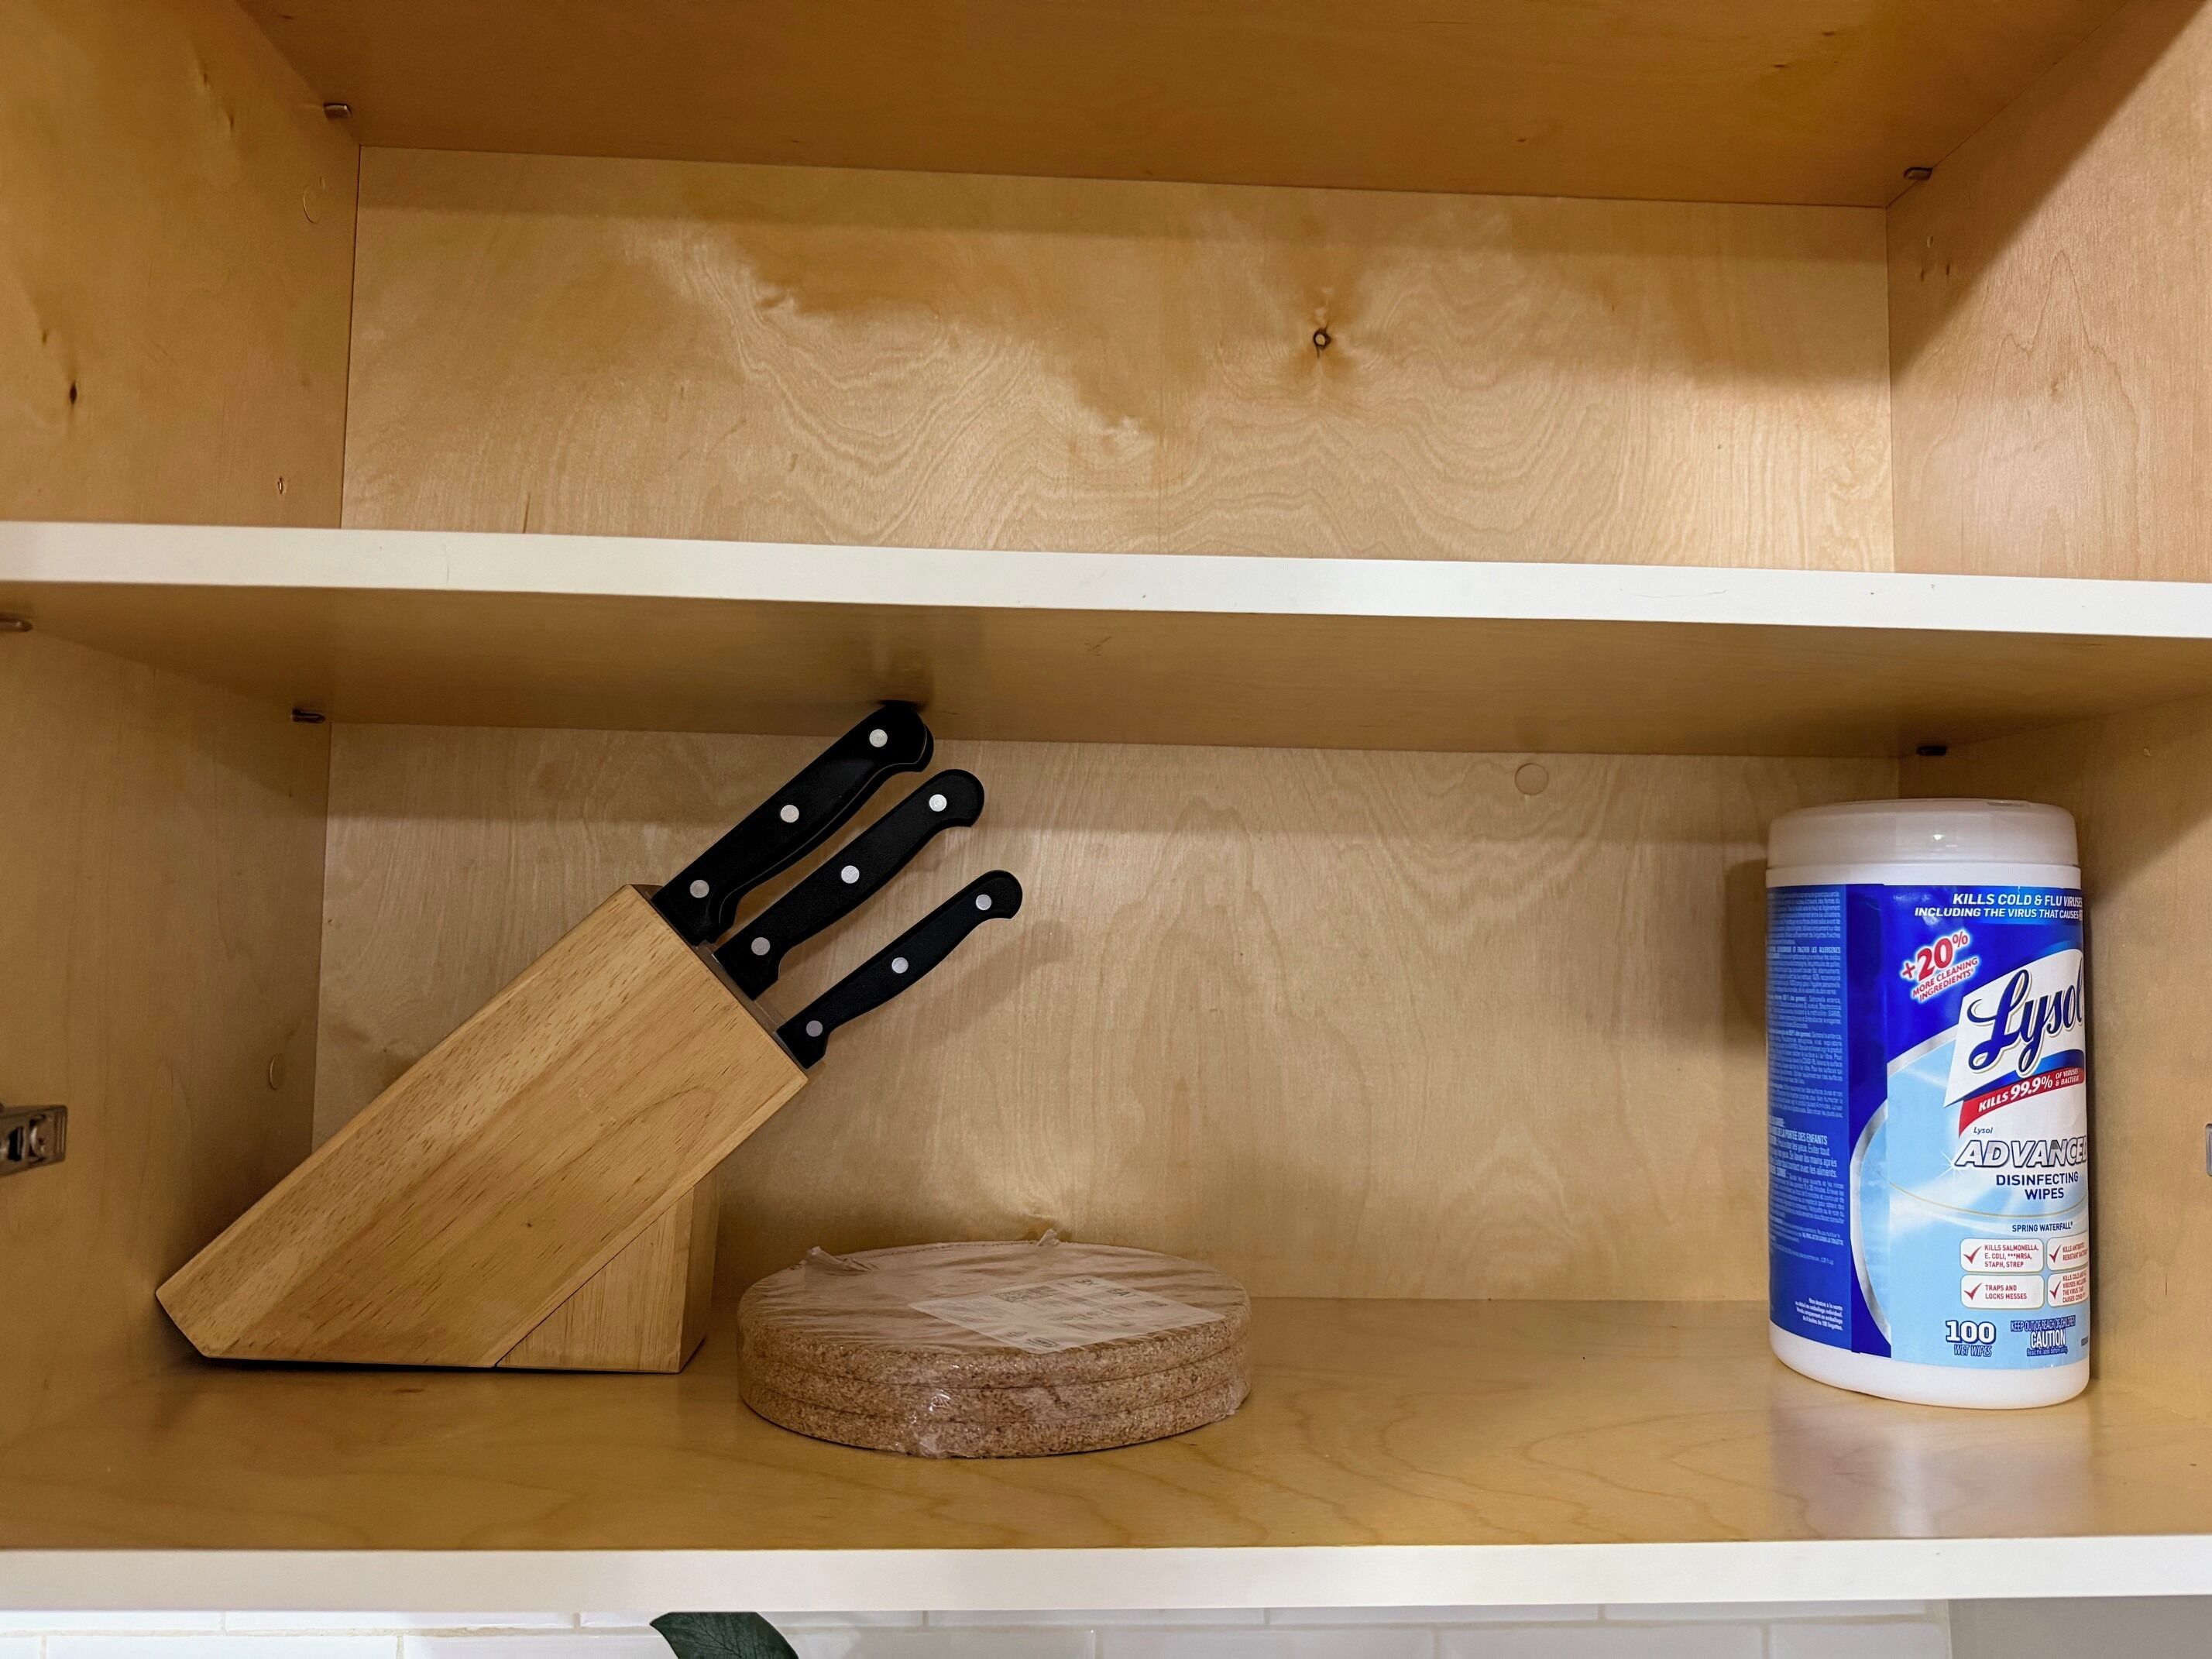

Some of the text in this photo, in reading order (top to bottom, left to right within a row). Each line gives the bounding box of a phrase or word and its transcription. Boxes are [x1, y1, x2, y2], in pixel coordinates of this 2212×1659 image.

[1953, 893, 1995, 905] KILLS
[1997, 894, 2032, 905] COLD
[2034, 895, 2043, 906] &
[2045, 895, 2063, 907] FLU
[1915, 907, 1981, 917] INCLUDING
[1984, 908, 2005, 917] THE
[2008, 908, 2037, 918] VIRUS
[2039, 909, 2059, 919] THAT
[2059, 909, 2079, 919] CAUSES
[1912, 957, 1978, 997] MORE CLEANING
[1966, 959, 2083, 1073] Lysol
[1978, 1075, 2053, 1113] KILLS 99.9%
[1973, 1126, 1994, 1135] Lysol
[1806, 1132, 1828, 1146] ENFANTS
[1996, 1171, 2079, 1186] DISINFECTING
[2025, 1187, 2064, 1200] WIPES
[2011, 1224, 2039, 1233] SPRING
[1946, 1320, 1996, 1345] 100
[2011, 1321, 2025, 1332] KEEP
[2031, 1329, 2066, 1348] CAUTION
[1954, 1345, 1993, 1358] WET WIPES
